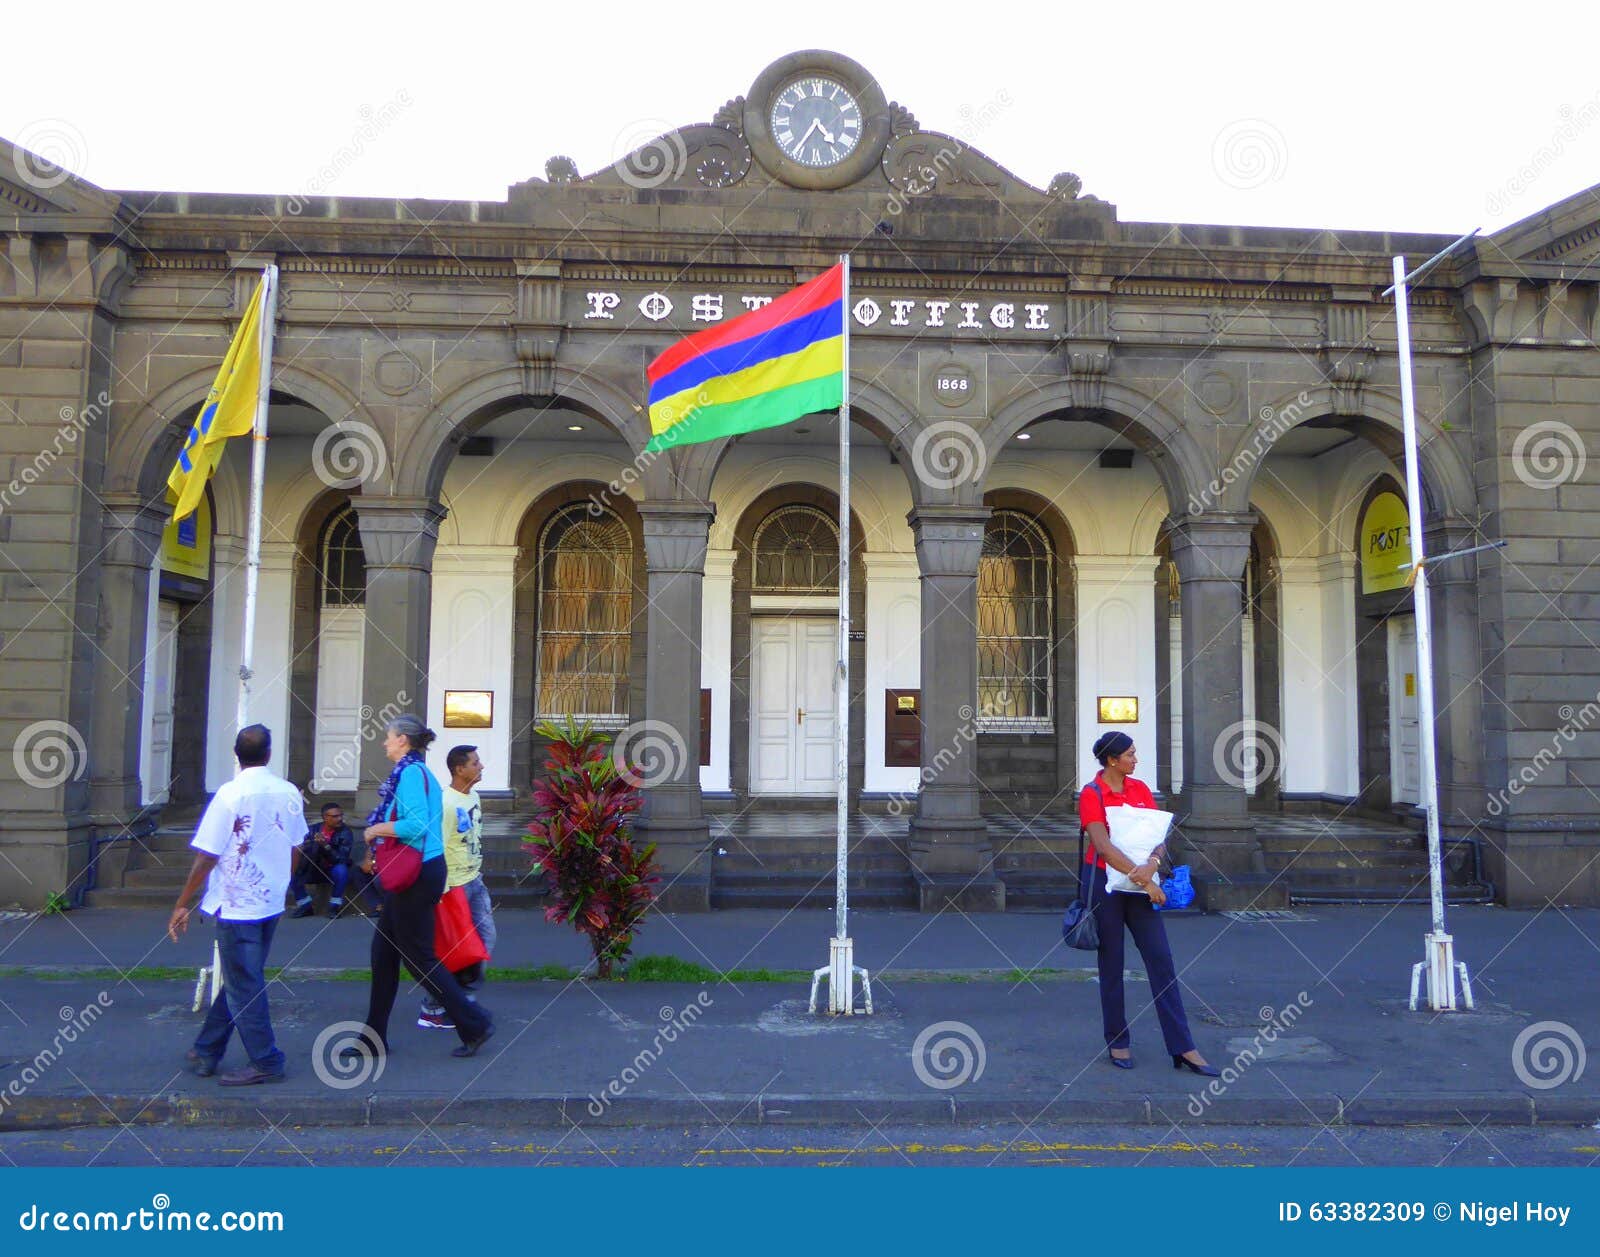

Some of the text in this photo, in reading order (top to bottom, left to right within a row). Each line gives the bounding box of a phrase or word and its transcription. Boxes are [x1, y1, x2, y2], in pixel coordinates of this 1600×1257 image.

[584, 291, 1050, 330] POST OFFICE
[937, 378, 968, 390] 1868
